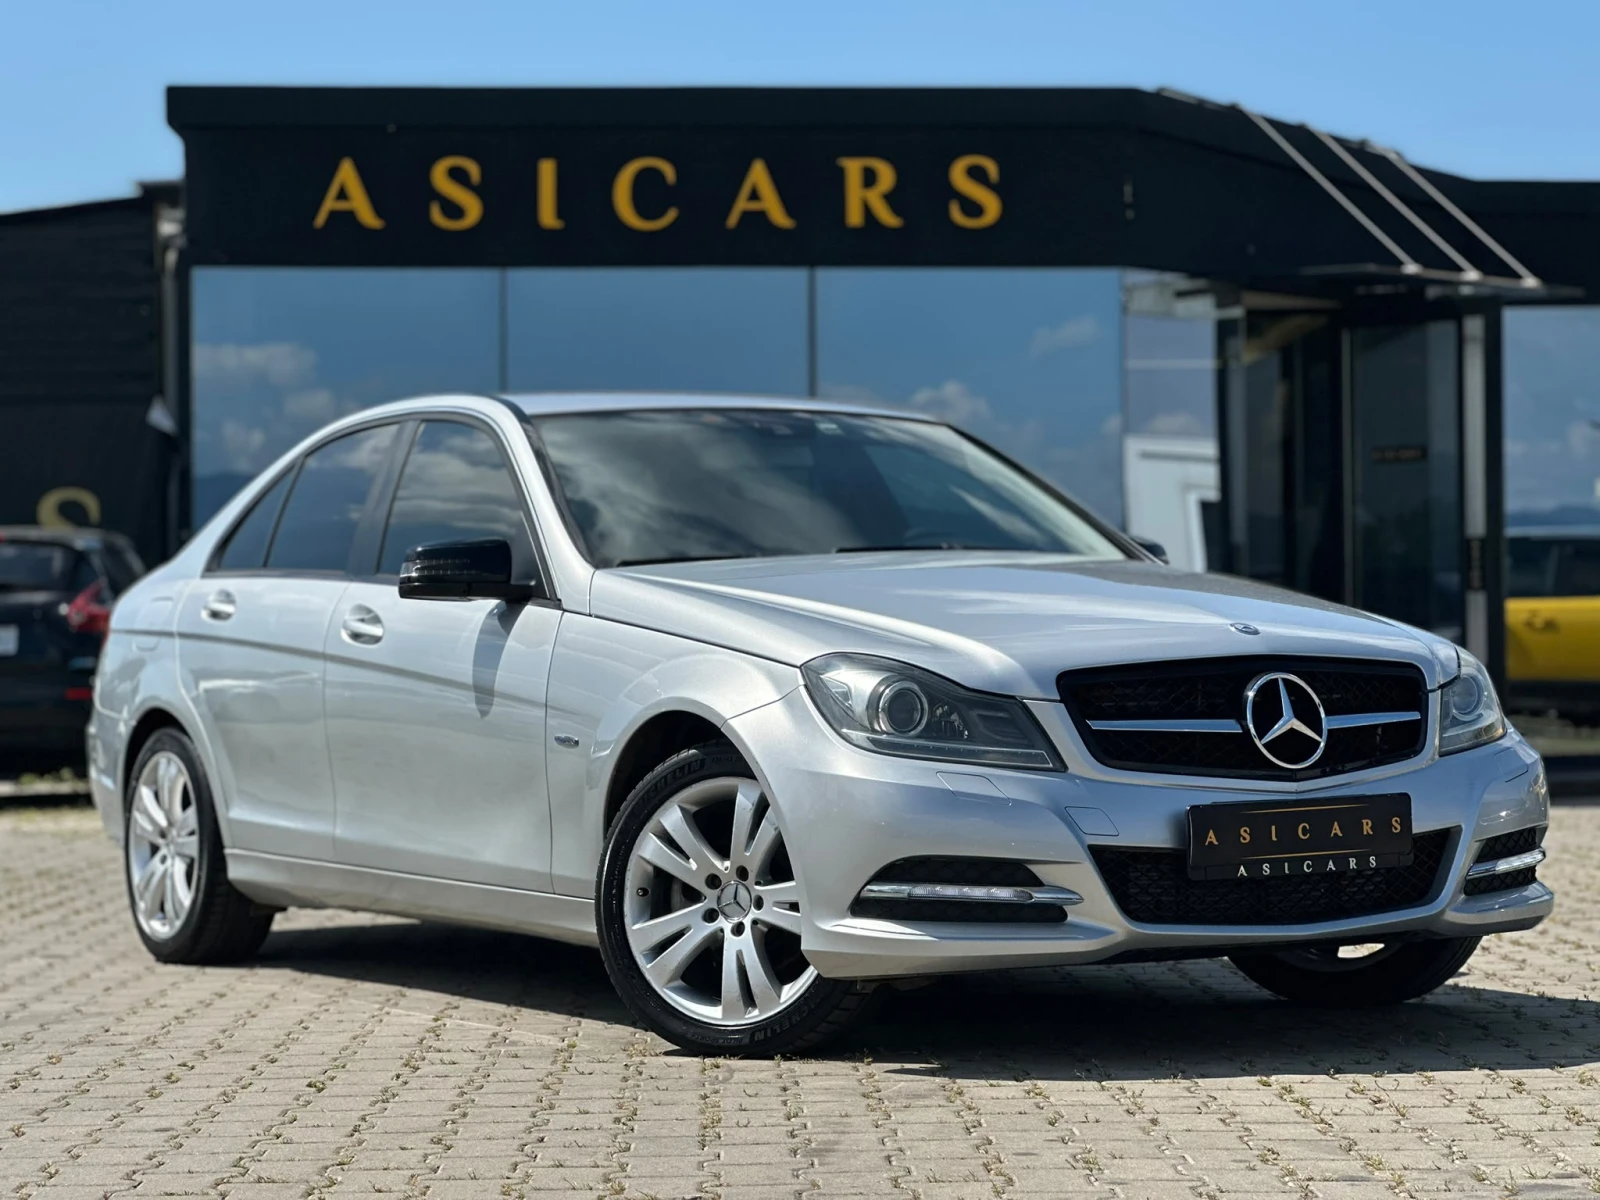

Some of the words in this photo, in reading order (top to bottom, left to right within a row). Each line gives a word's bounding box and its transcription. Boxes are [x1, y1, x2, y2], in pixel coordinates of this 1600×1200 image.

[312, 155, 1003, 231] ASICARS
[1205, 816, 1401, 846] ASICARS
[1237, 855, 1377, 877] ASICARS
